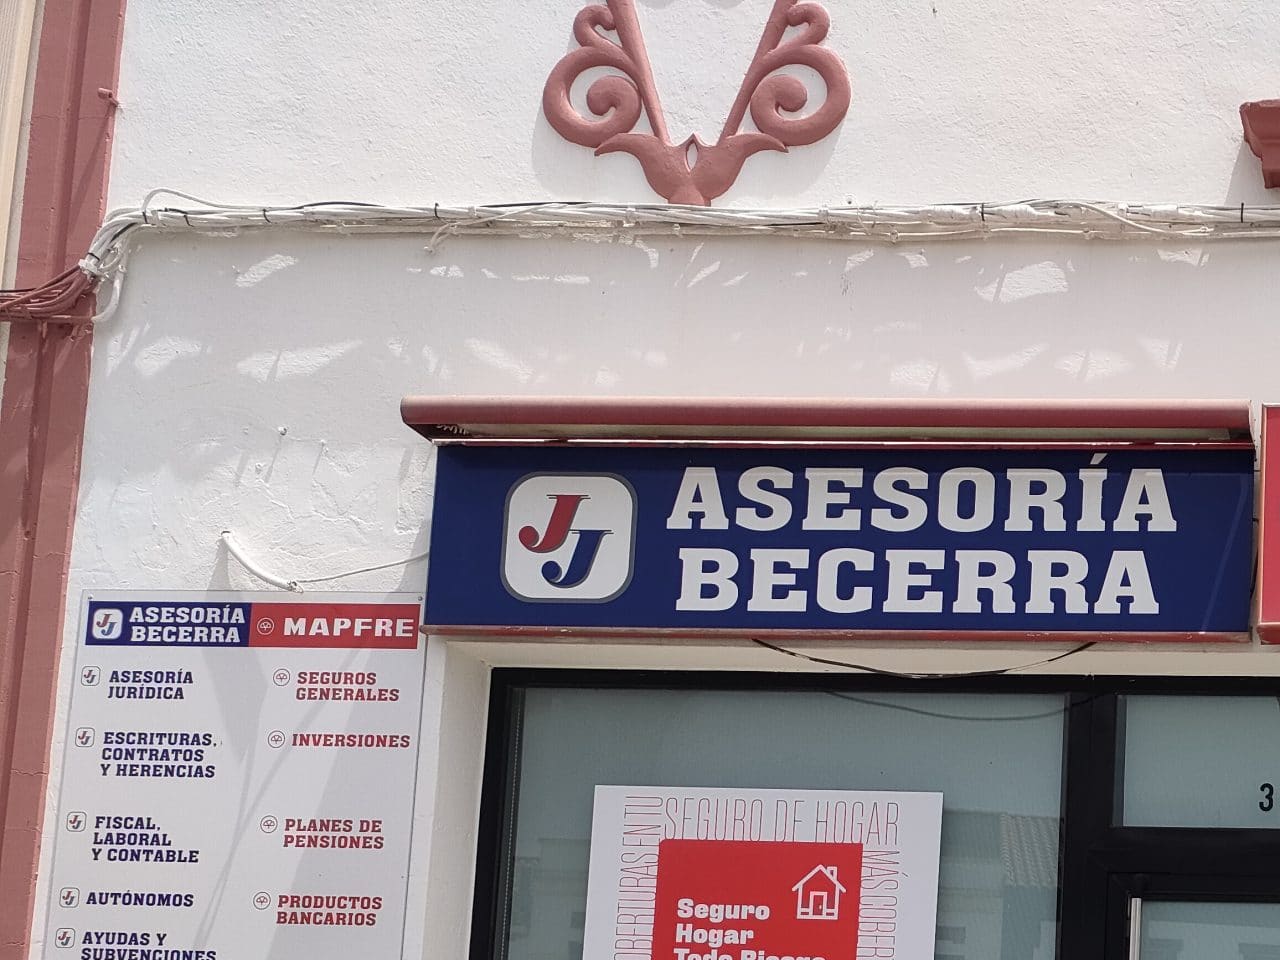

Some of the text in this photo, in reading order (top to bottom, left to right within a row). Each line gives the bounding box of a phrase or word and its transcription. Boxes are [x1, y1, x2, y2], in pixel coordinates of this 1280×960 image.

[665, 455, 1177, 533] ASESORÍA
[675, 546, 1159, 615] BECERRA
[130, 604, 245, 625] ASESORÍA
[131, 625, 241, 644] BECERRA
[284, 617, 414, 638] MAPFRE
[109, 667, 194, 684] ASESORÍA
[297, 672, 377, 686] SEGUROS
[107, 683, 185, 700] JURÍDICA
[295, 687, 400, 702] GENERALES
[292, 733, 411, 748] INVERSIONES
[101, 748, 205, 762] CONTRATOS
[100, 763, 216, 779] Y HERENCIAS
[1258, 782, 1275, 812] 3
[624, 796, 664, 819] TU
[94, 816, 161, 831] FISCAL,
[284, 818, 382, 834] PLANES DE
[665, 797, 899, 846] SEGURO DE HOGAR
[92, 832, 172, 847] LABORAL
[283, 835, 384, 850] PENSIONES
[622, 824, 662, 847] EN
[91, 848, 200, 863] Y CONTABLE
[861, 851, 909, 890] MÁS
[86, 890, 195, 908] AUTÓNOMOS
[277, 894, 383, 910] PRODUCTOS
[276, 910, 377, 926] BANCARIOS
[677, 898, 770, 923] Seguro
[81, 931, 167, 947] AYUDAS Y
[676, 923, 754, 947] Hogar
